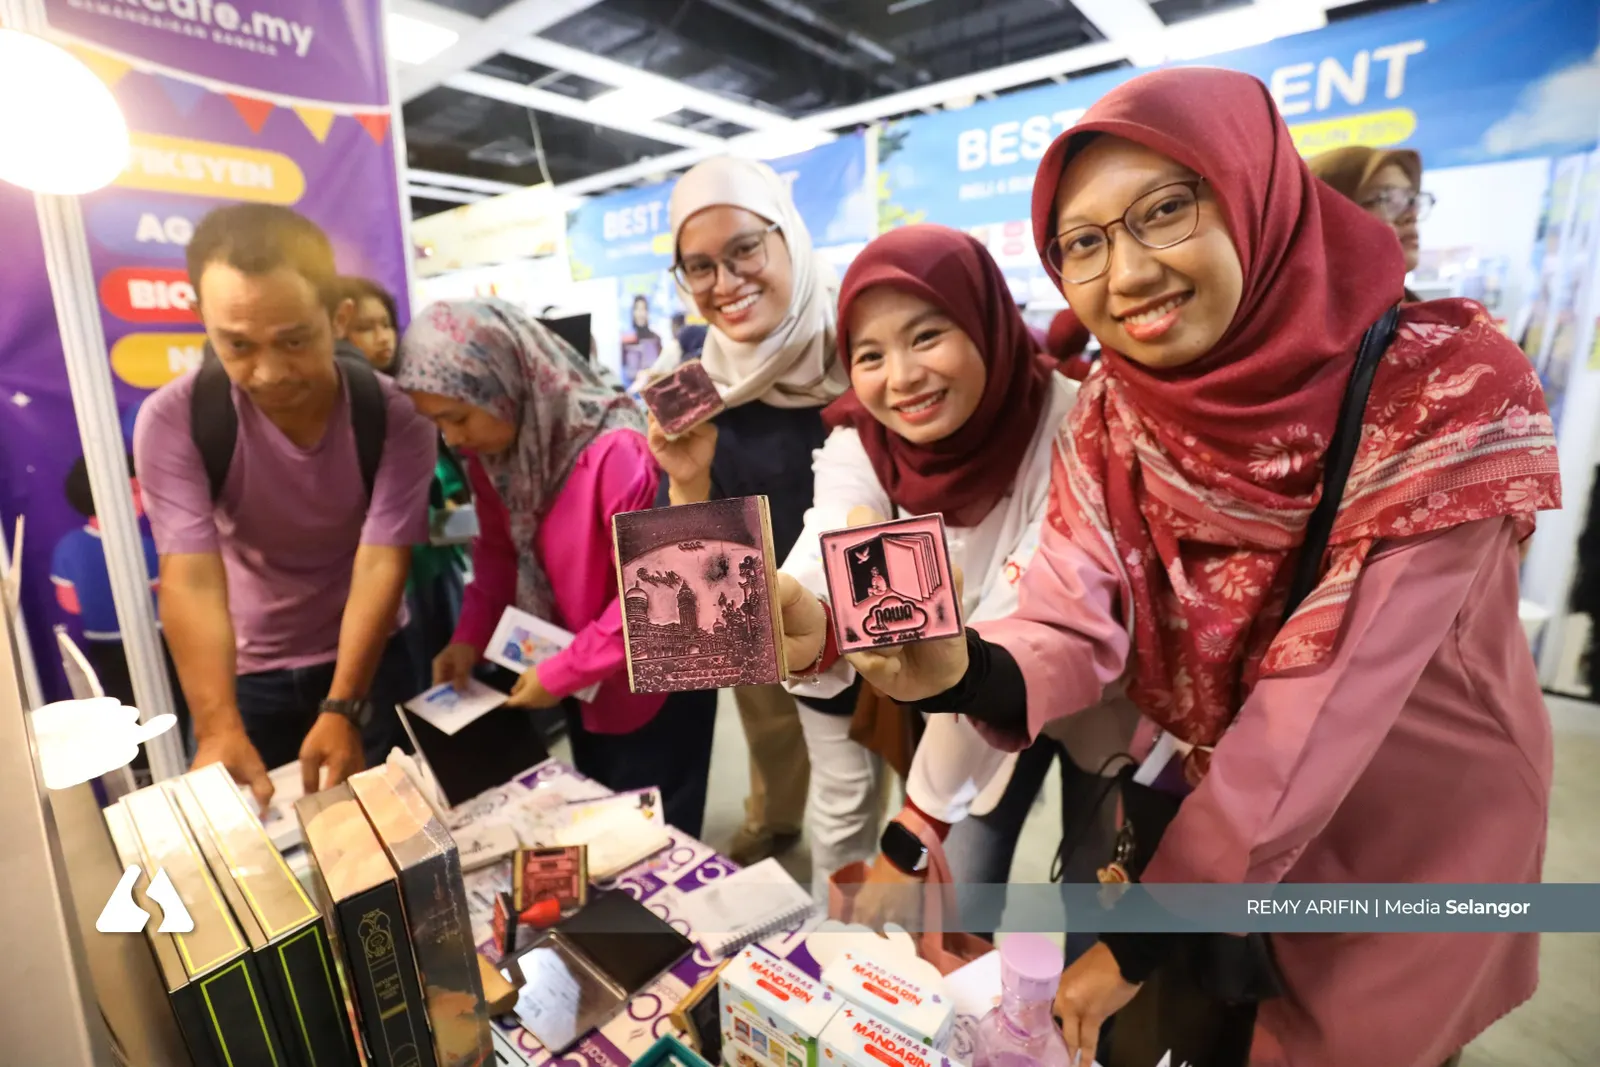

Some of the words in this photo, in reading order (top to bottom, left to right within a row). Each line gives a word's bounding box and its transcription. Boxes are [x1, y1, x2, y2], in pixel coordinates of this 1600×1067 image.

[1271, 40, 1426, 116] ENT
[603, 200, 664, 242] BEST
[127, 279, 197, 310] BIO
[750, 961, 815, 1005] MANDARIN
[851, 963, 924, 1006] MANDARIN
[867, 1018, 891, 1036] KAD
